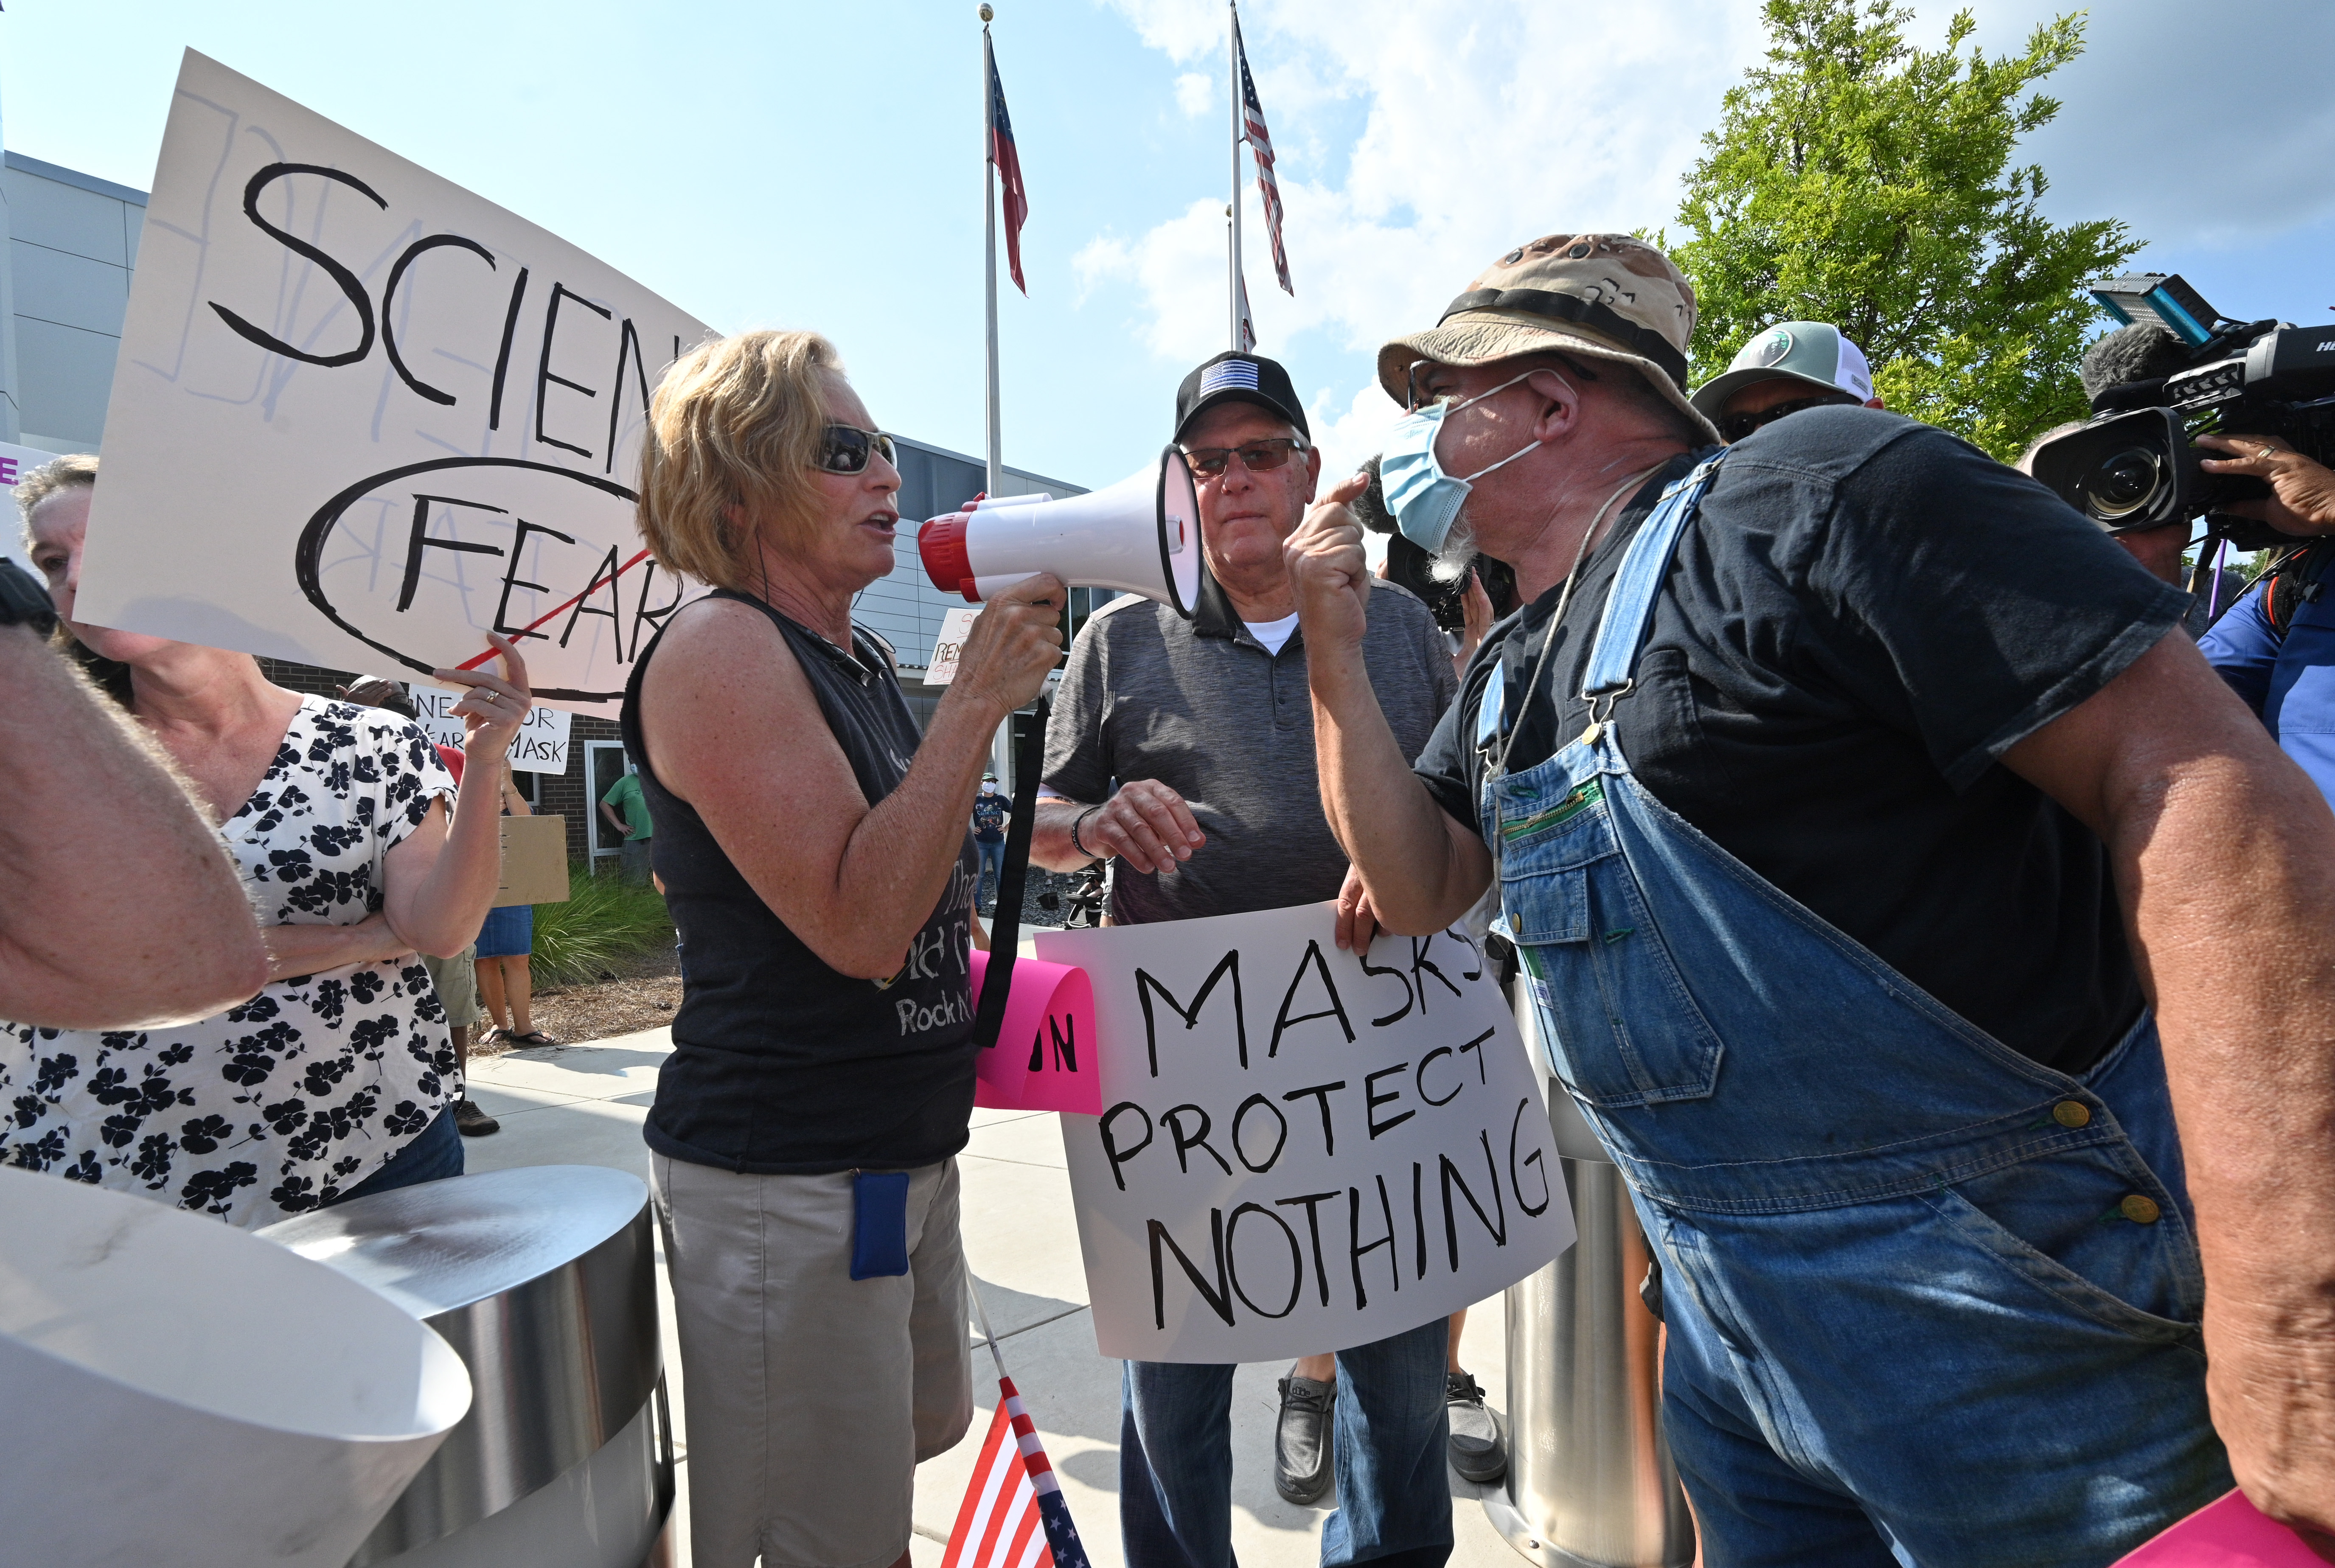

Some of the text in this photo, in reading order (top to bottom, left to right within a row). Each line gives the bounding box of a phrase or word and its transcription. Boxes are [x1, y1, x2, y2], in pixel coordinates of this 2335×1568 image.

[396, 492, 684, 665] FEAR
[511, 732, 566, 763] MASK
[895, 990, 956, 1036] Rock
[1099, 1025, 1495, 1190] PROTECT
[1146, 1098, 1549, 1330] NOTHING
